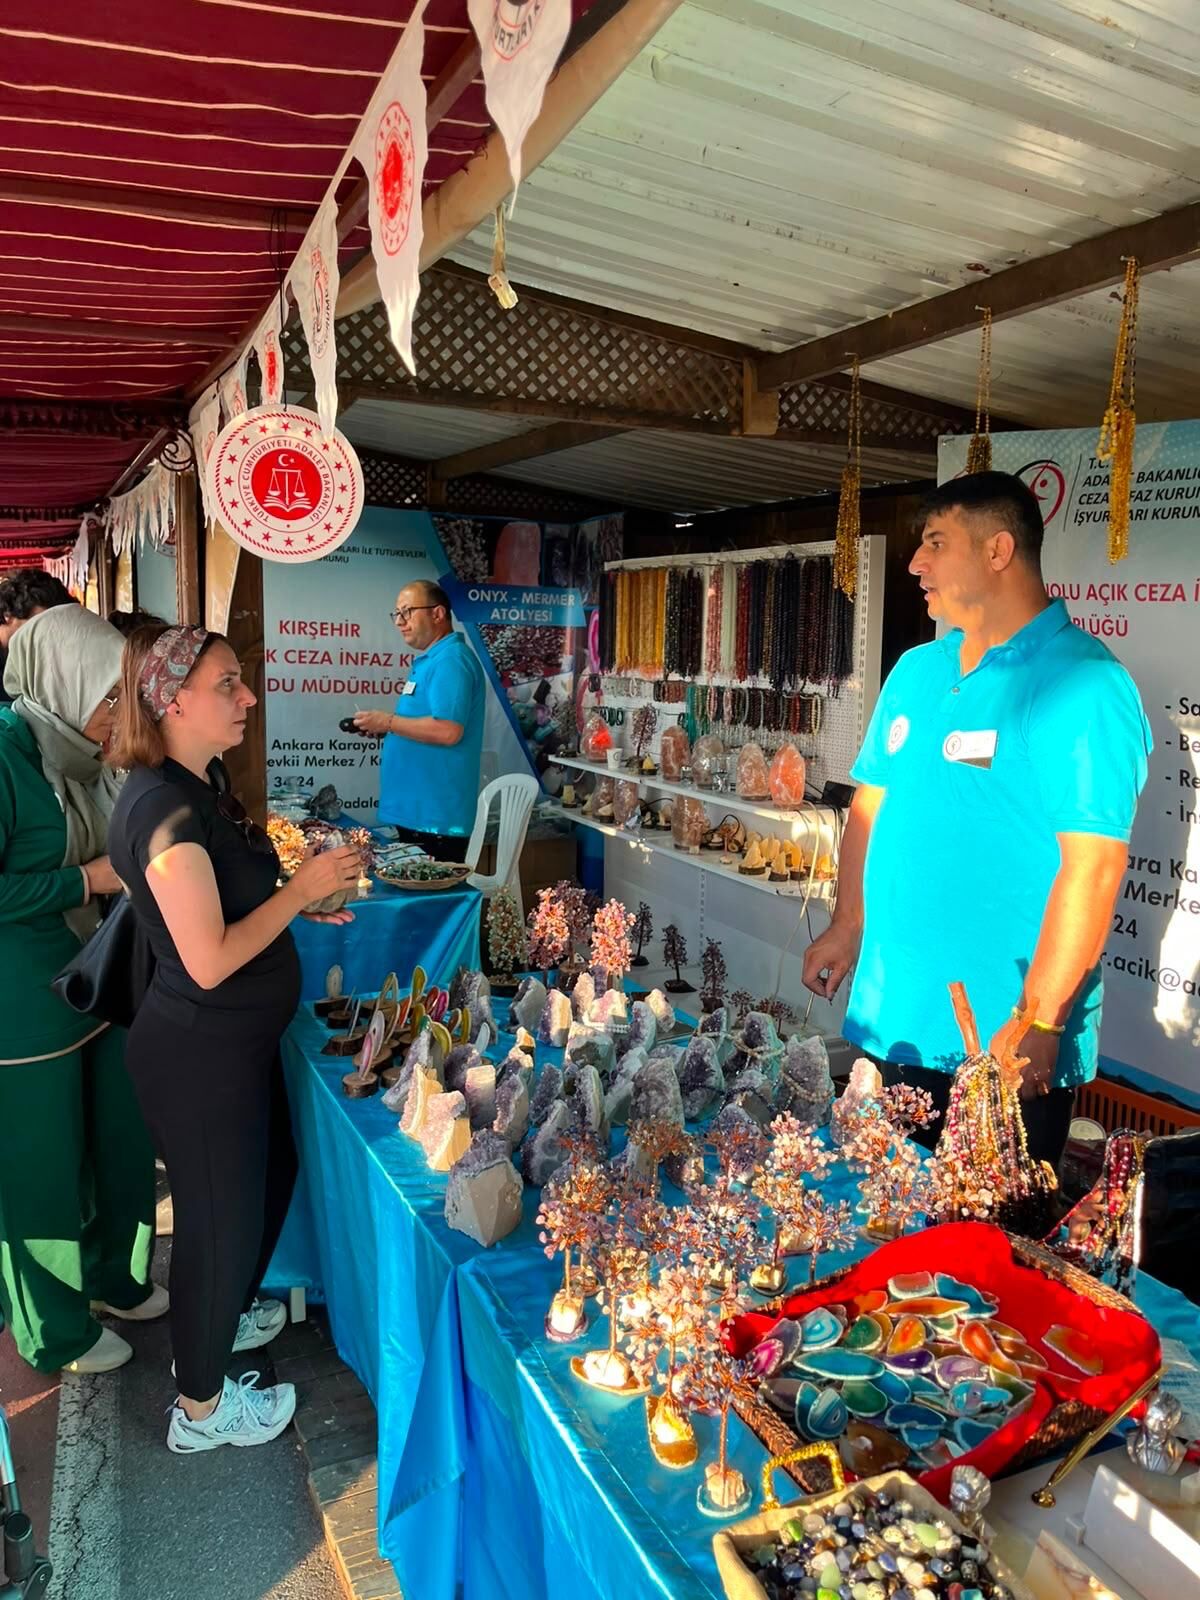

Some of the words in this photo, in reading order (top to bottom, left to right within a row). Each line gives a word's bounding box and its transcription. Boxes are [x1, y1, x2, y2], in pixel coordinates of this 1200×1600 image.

[242, 484, 270, 523] TÜRKİYE
[294, 442, 326, 470] ADALET
[310, 473, 332, 522] BAKANLIĞI
[1078, 492, 1109, 505] CEZA
[467, 589, 508, 603] ONYX
[521, 592, 576, 606] MERMER
[1086, 583, 1129, 606] AÇIK
[1134, 583, 1187, 602] CEZA
[490, 606, 553, 622] ATÖLYESİ
[279, 619, 361, 640] KIRŞEHİR
[283, 649, 333, 665] CEZA
[339, 647, 394, 667] İNFAZ
[301, 675, 405, 695] MÜDÜRLÜĞ
[271, 739, 324, 751] Ankara
[266, 755, 300, 767] evkii
[304, 755, 355, 768] Merkez
[296, 776, 315, 787] 24
[1180, 799, 1200, 824] İn
[1127, 854, 1161, 875] ara
[1112, 913, 1138, 939] 24
